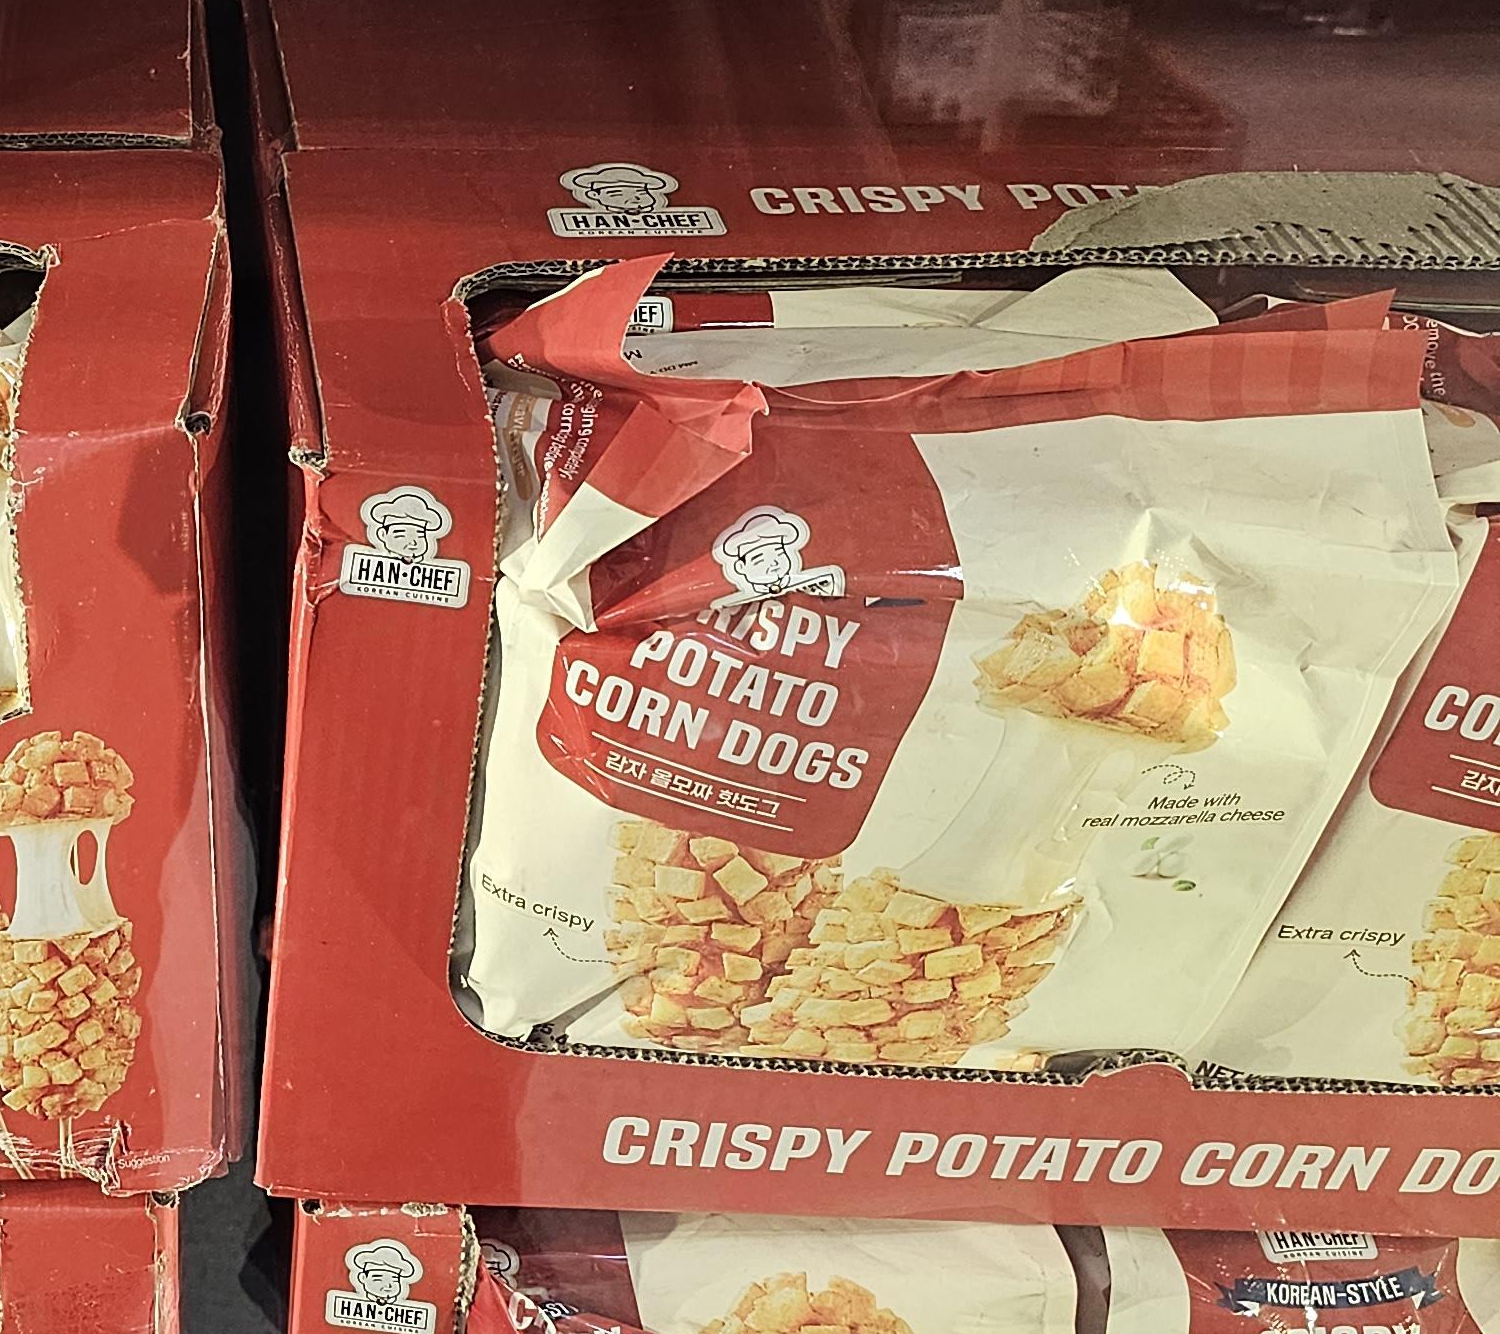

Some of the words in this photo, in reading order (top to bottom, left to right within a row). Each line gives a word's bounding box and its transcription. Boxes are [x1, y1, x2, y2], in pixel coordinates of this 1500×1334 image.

[749, 183, 988, 216] CRISPY
[356, 586, 400, 597] KOREAN
[405, 592, 450, 603] CUISINE
[629, 630, 839, 728] POTATO
[564, 658, 711, 750] CORN
[716, 710, 870, 791] DOGS
[604, 750, 648, 780] 감자
[716, 780, 780, 818] 핫도그
[1146, 793, 1200, 811] Made
[1202, 791, 1243, 809] with
[1080, 813, 1118, 830] real
[1119, 809, 1218, 827] mozzarella
[1219, 806, 1287, 824] cheese
[478, 871, 525, 909] Extra
[526, 892, 596, 933] crispy
[1276, 924, 1334, 941] Extra
[1338, 926, 1407, 948] crispy
[601, 1115, 870, 1176] CRISPY
[886, 1131, 1164, 1185] POTATO
[1179, 1141, 1391, 1192] CORN
[1265, 1276, 1405, 1307] KOREAN-STYLE
